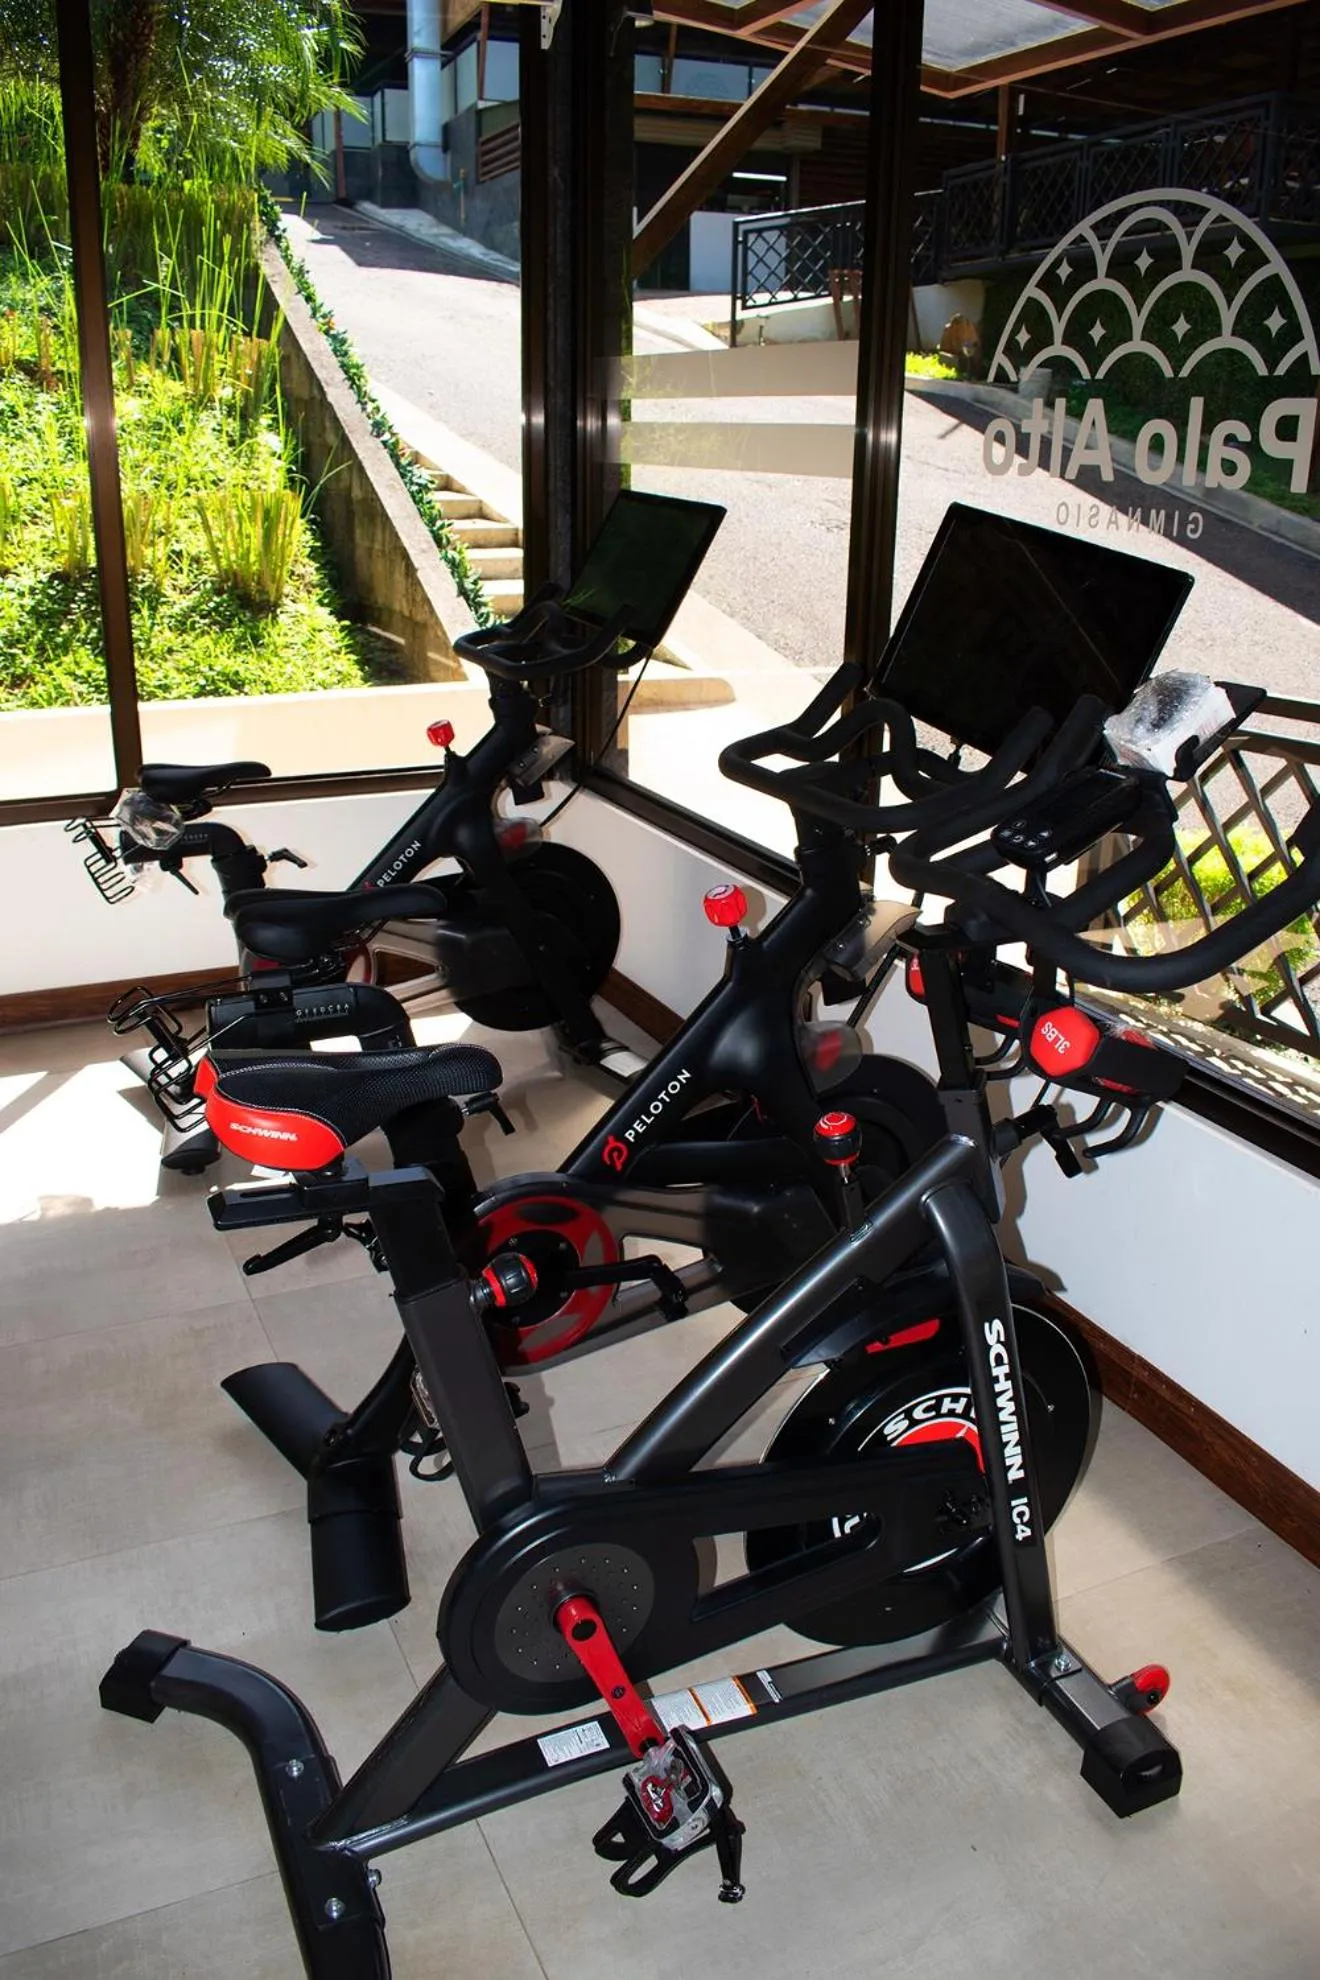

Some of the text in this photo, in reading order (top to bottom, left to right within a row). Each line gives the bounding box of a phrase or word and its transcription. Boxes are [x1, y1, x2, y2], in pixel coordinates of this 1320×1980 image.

[376, 840, 422, 888] PELOTON
[624, 1068, 692, 1143] PELOTON
[229, 1122, 298, 1141] SCHWINN
[883, 1397, 976, 1441] SCH
[984, 1318, 1032, 1542] SCHWINN IC4
